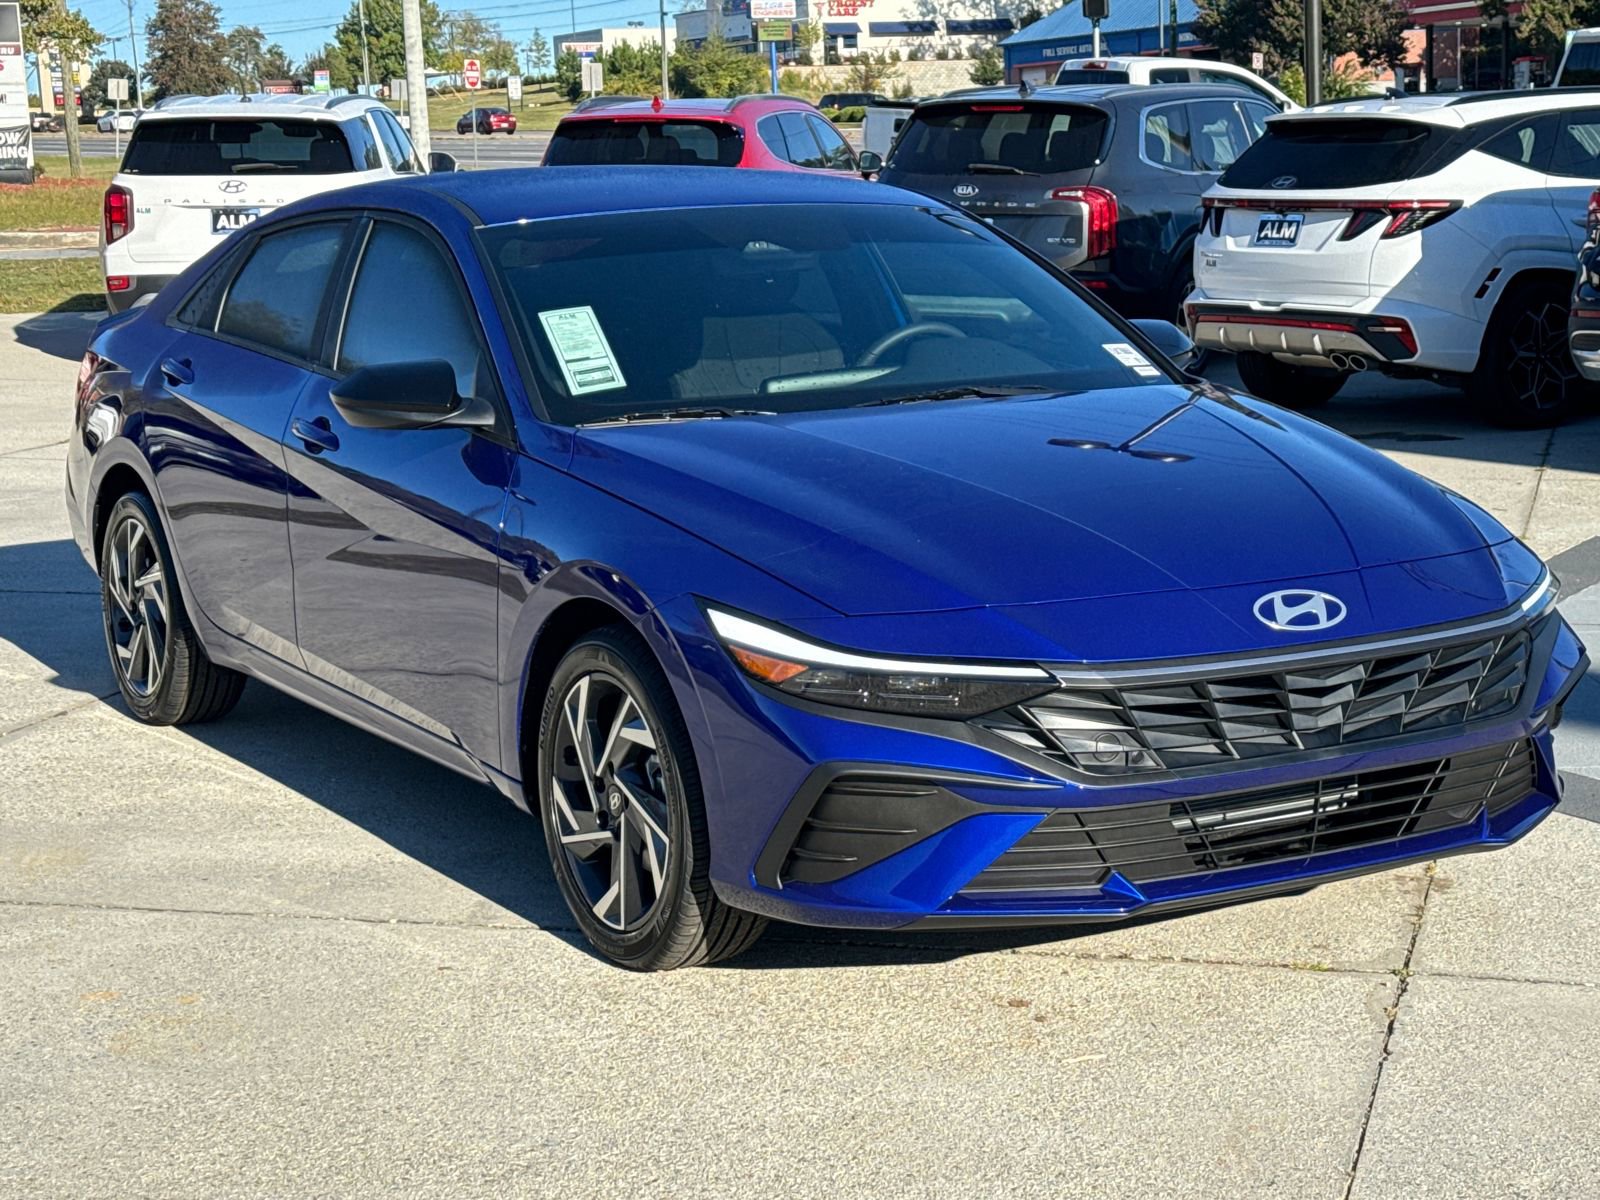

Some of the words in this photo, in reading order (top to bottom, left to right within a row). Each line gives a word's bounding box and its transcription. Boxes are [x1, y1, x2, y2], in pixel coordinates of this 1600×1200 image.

[828, 8, 859, 16] CARE
[1056, 45, 1077, 55] SERVICE
[0, 146, 28, 159] ING
[957, 186, 974, 194] KIA
[1260, 221, 1298, 239] ALM
[539, 686, 555, 750] KUMHO
